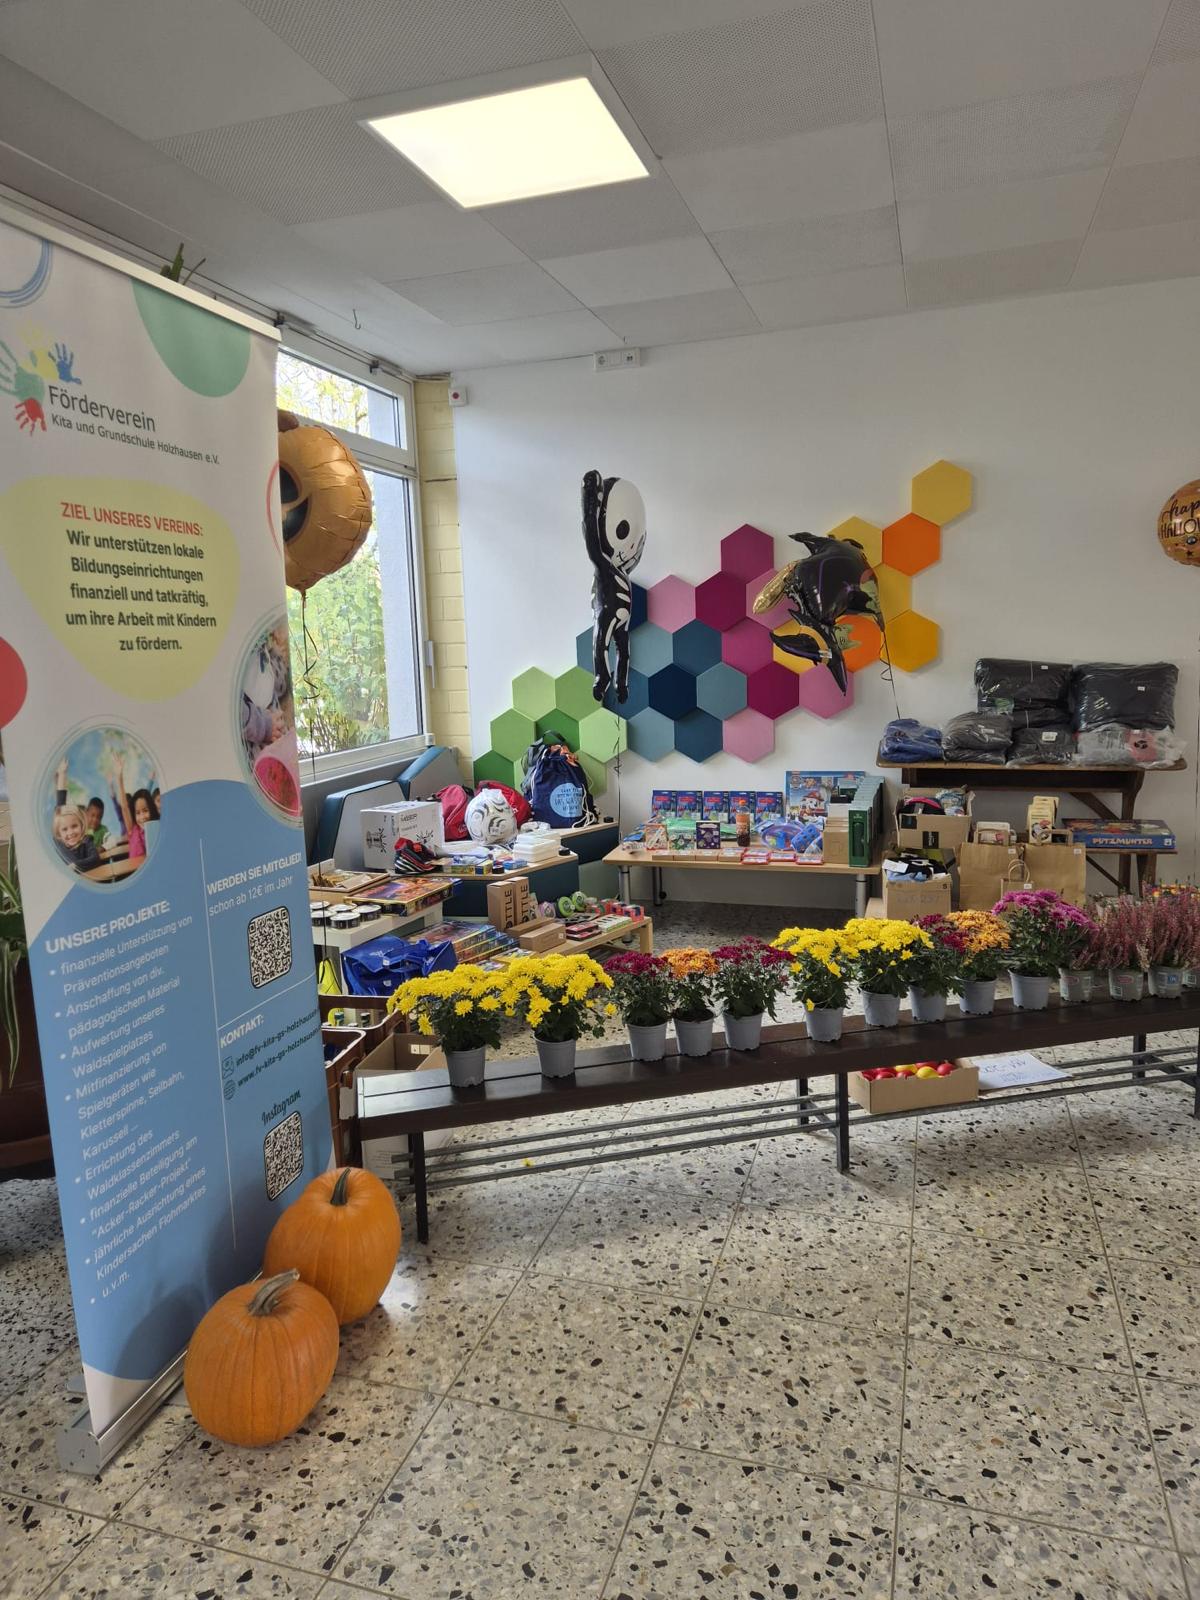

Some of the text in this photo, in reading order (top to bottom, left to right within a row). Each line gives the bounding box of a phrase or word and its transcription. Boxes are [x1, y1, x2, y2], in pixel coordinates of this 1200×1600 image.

[48, 384, 156, 432] Förderverein
[52, 413, 220, 464] Kita und Grundschule Holzhausen e.V.
[61, 502, 204, 536] ZIEL UNSERES VEREINS:
[1162, 499, 1200, 523] hap
[66, 530, 204, 560] Wir unterstützen lokale
[70, 556, 204, 584] Bildungseinrichtungen
[66, 610, 216, 628] um ihre Arbeit mit Kindern
[70, 582, 208, 608] finanziell und tatkräftig,
[120, 636, 182, 651] zu fördern.
[206, 852, 302, 896] WERDEN SIE MITGLIED!
[208, 876, 294, 916] schon ab 12€ im Jahr
[45, 900, 171, 954] UNSERE PROJEKTE:
[505, 890, 513, 928] OTTLE
[520, 884, 528, 922] OTTLE
[60, 915, 193, 976] finanzielle Unterstützung von
[64, 945, 169, 996] Präventionsangeboten
[66, 966, 164, 1017] Anschaffung von div.
[68, 976, 180, 1040] pädagogischem Material
[72, 1004, 166, 1058] Aufwertung unseres
[220, 1014, 264, 1048] KONTAKT:
[72, 1030, 154, 1078] Waldspielplatzes
[76, 1042, 166, 1100] Mitfinanzierung von
[78, 1068, 156, 1120] Spielgeräten wie
[80, 1071, 185, 1140] Kletterspinne, Seilbahn,
[262, 1090, 301, 1126] Instagram
[82, 1123, 128, 1160] Karussell
[85, 1130, 153, 1181] Errichtung des
[88, 1130, 180, 1200] Waldklassenzimmers
[90, 1136, 198, 1222] finanzielle Beteiligung am
[94, 1166, 206, 1265] jährliche Ausrichtung eines
[96, 1185, 208, 1280] Kindersachen Flohmarktes
[102, 1270, 130, 1298] u.v.m.
